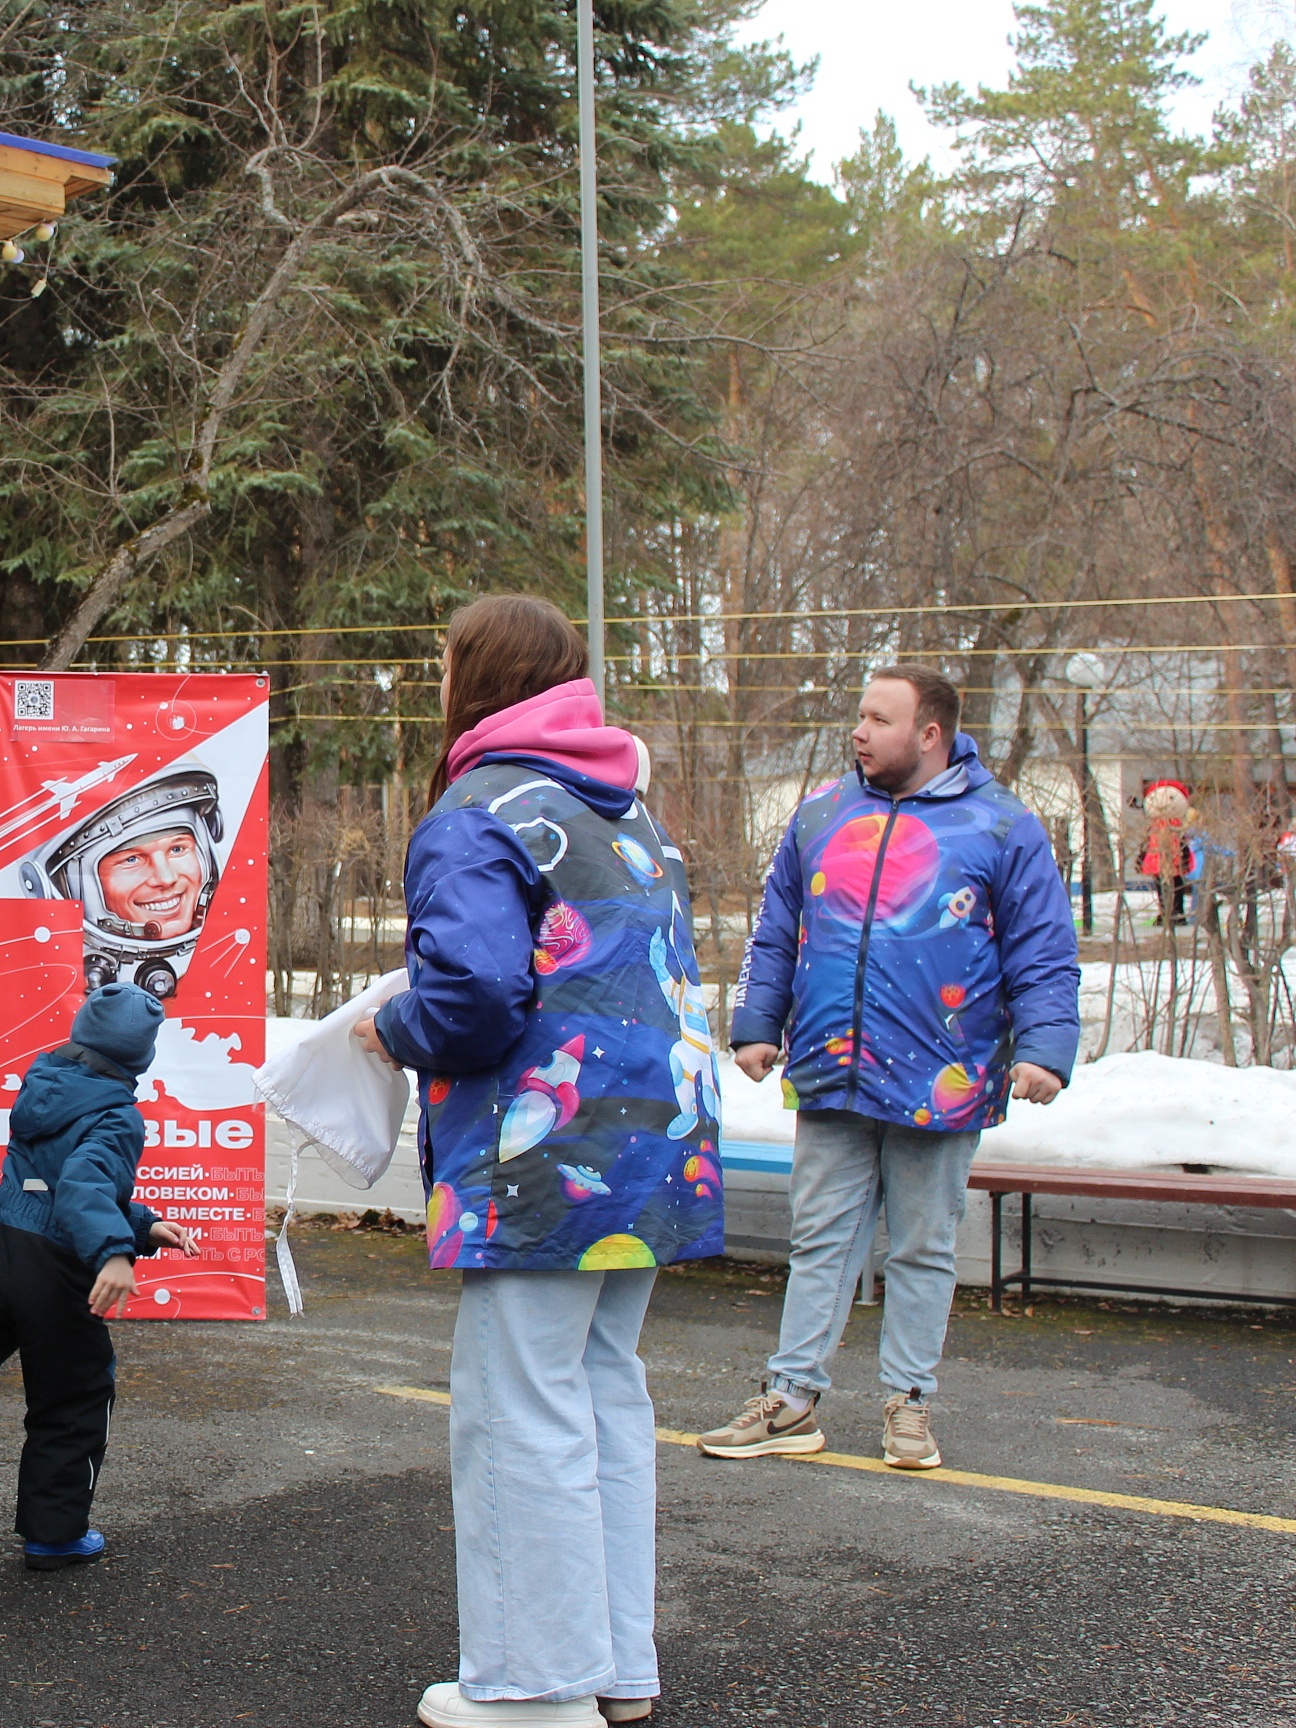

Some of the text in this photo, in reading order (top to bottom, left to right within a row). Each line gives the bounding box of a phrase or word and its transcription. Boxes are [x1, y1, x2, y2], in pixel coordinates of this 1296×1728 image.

[13, 724, 37, 732] Лагерь
[80, 725, 111, 733] Гагарина
[136, 1164, 204, 1181] ССИЕЙ
[131, 1186, 229, 1201] ЛОВЕКОМ
[167, 1207, 245, 1221] ВМЕСТЕ
